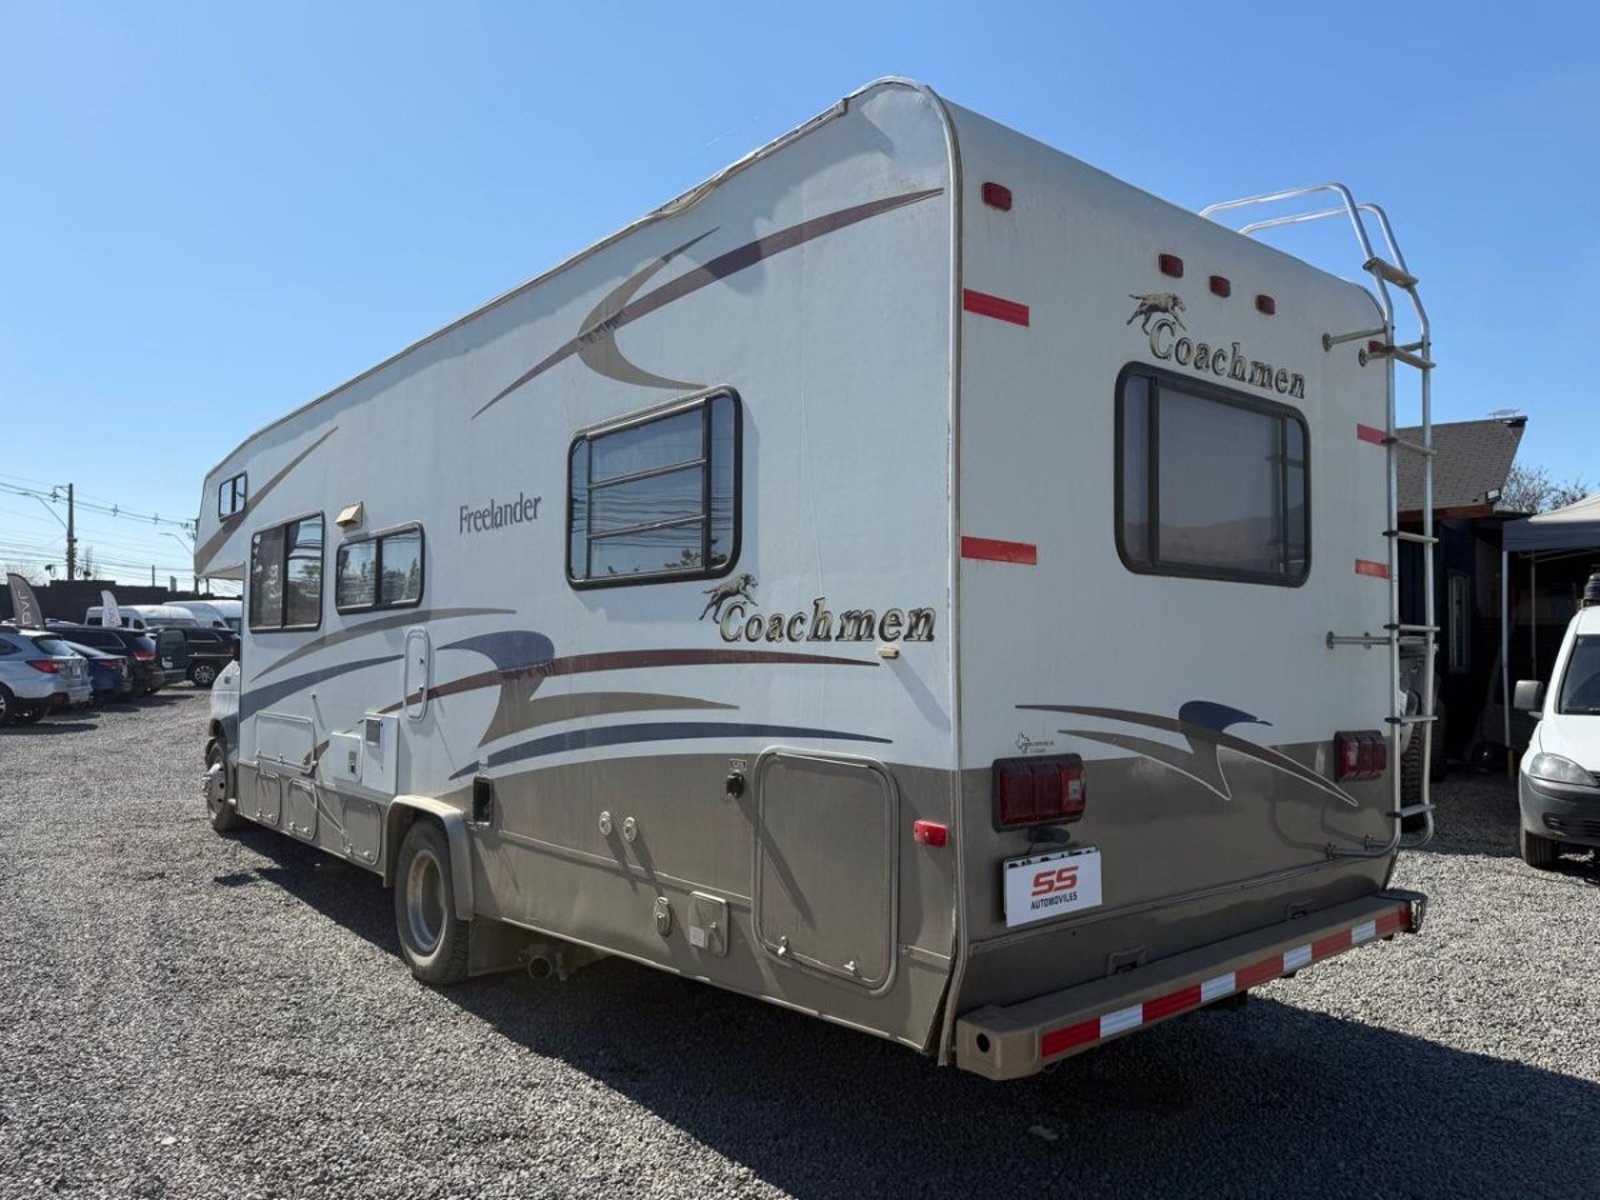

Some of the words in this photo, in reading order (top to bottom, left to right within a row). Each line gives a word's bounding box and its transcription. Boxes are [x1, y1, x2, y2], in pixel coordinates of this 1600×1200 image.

[1149, 319, 1305, 399] Coachmen
[459, 492, 541, 533] Freelander
[720, 597, 935, 643] Coachmen
[1031, 867, 1079, 897] SS
[1031, 892, 1078, 910] AUTOMOVILES
